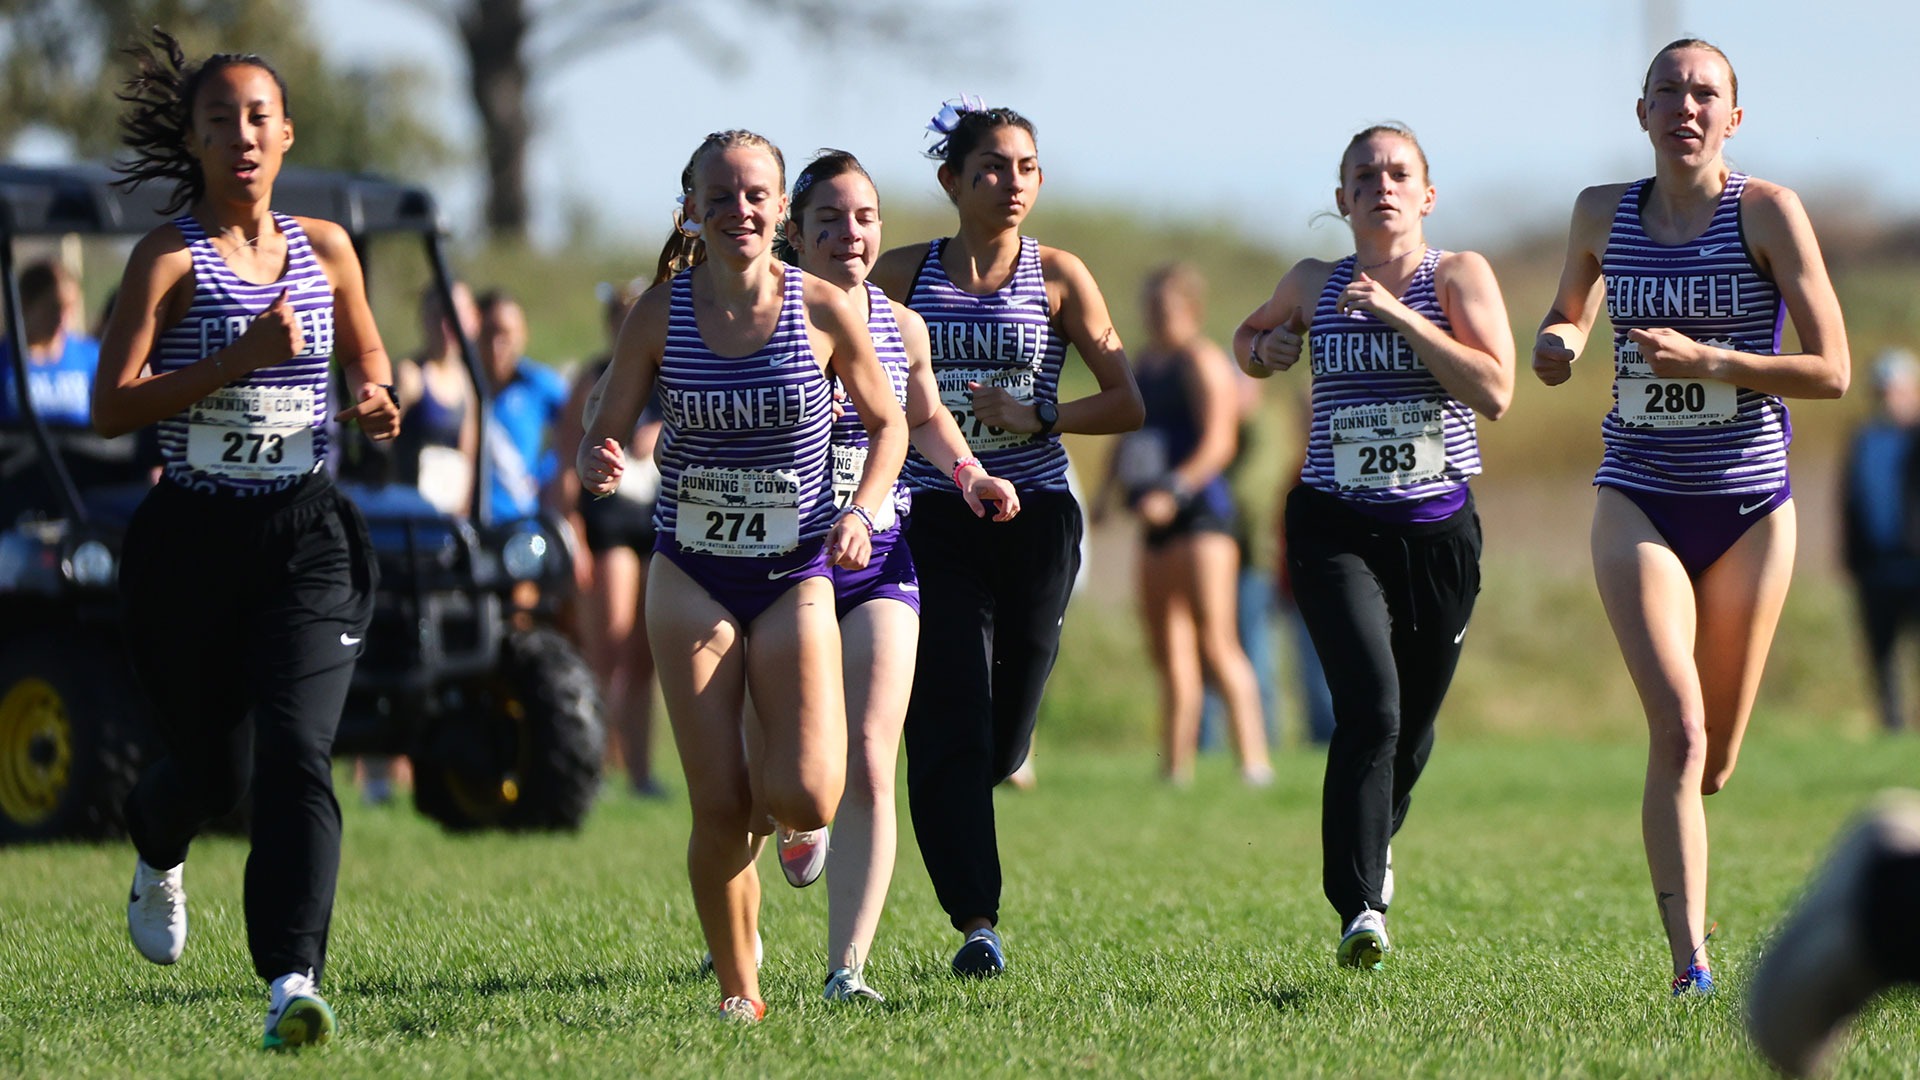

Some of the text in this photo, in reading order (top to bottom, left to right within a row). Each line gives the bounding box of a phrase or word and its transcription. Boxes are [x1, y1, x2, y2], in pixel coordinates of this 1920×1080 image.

[1605, 275, 1748, 317] CORNELL
[201, 307, 334, 359] COELL
[927, 321, 1042, 364] ORNELL
[1312, 332, 1428, 375] CORNEL
[937, 374, 1031, 392] NNIN COWS
[943, 372, 978, 380] CARLETON
[274, 399, 310, 412] COWS
[667, 384, 811, 429] CORNELL
[1350, 403, 1421, 417] CARLETON COLLEGE
[1644, 382, 1706, 414] 280
[1333, 414, 1388, 431] RUNNING
[1402, 408, 1441, 425] COWS
[1678, 412, 1720, 421] CHAMPIONSHIP
[222, 431, 284, 464] 273
[1359, 442, 1416, 475] 283
[681, 475, 739, 493] RUNNING
[754, 481, 798, 494] COWS
[701, 471, 776, 481] CARLETON COLLEGE
[705, 511, 766, 542] 274
[737, 543, 780, 551] CHAMPIONSHIP
